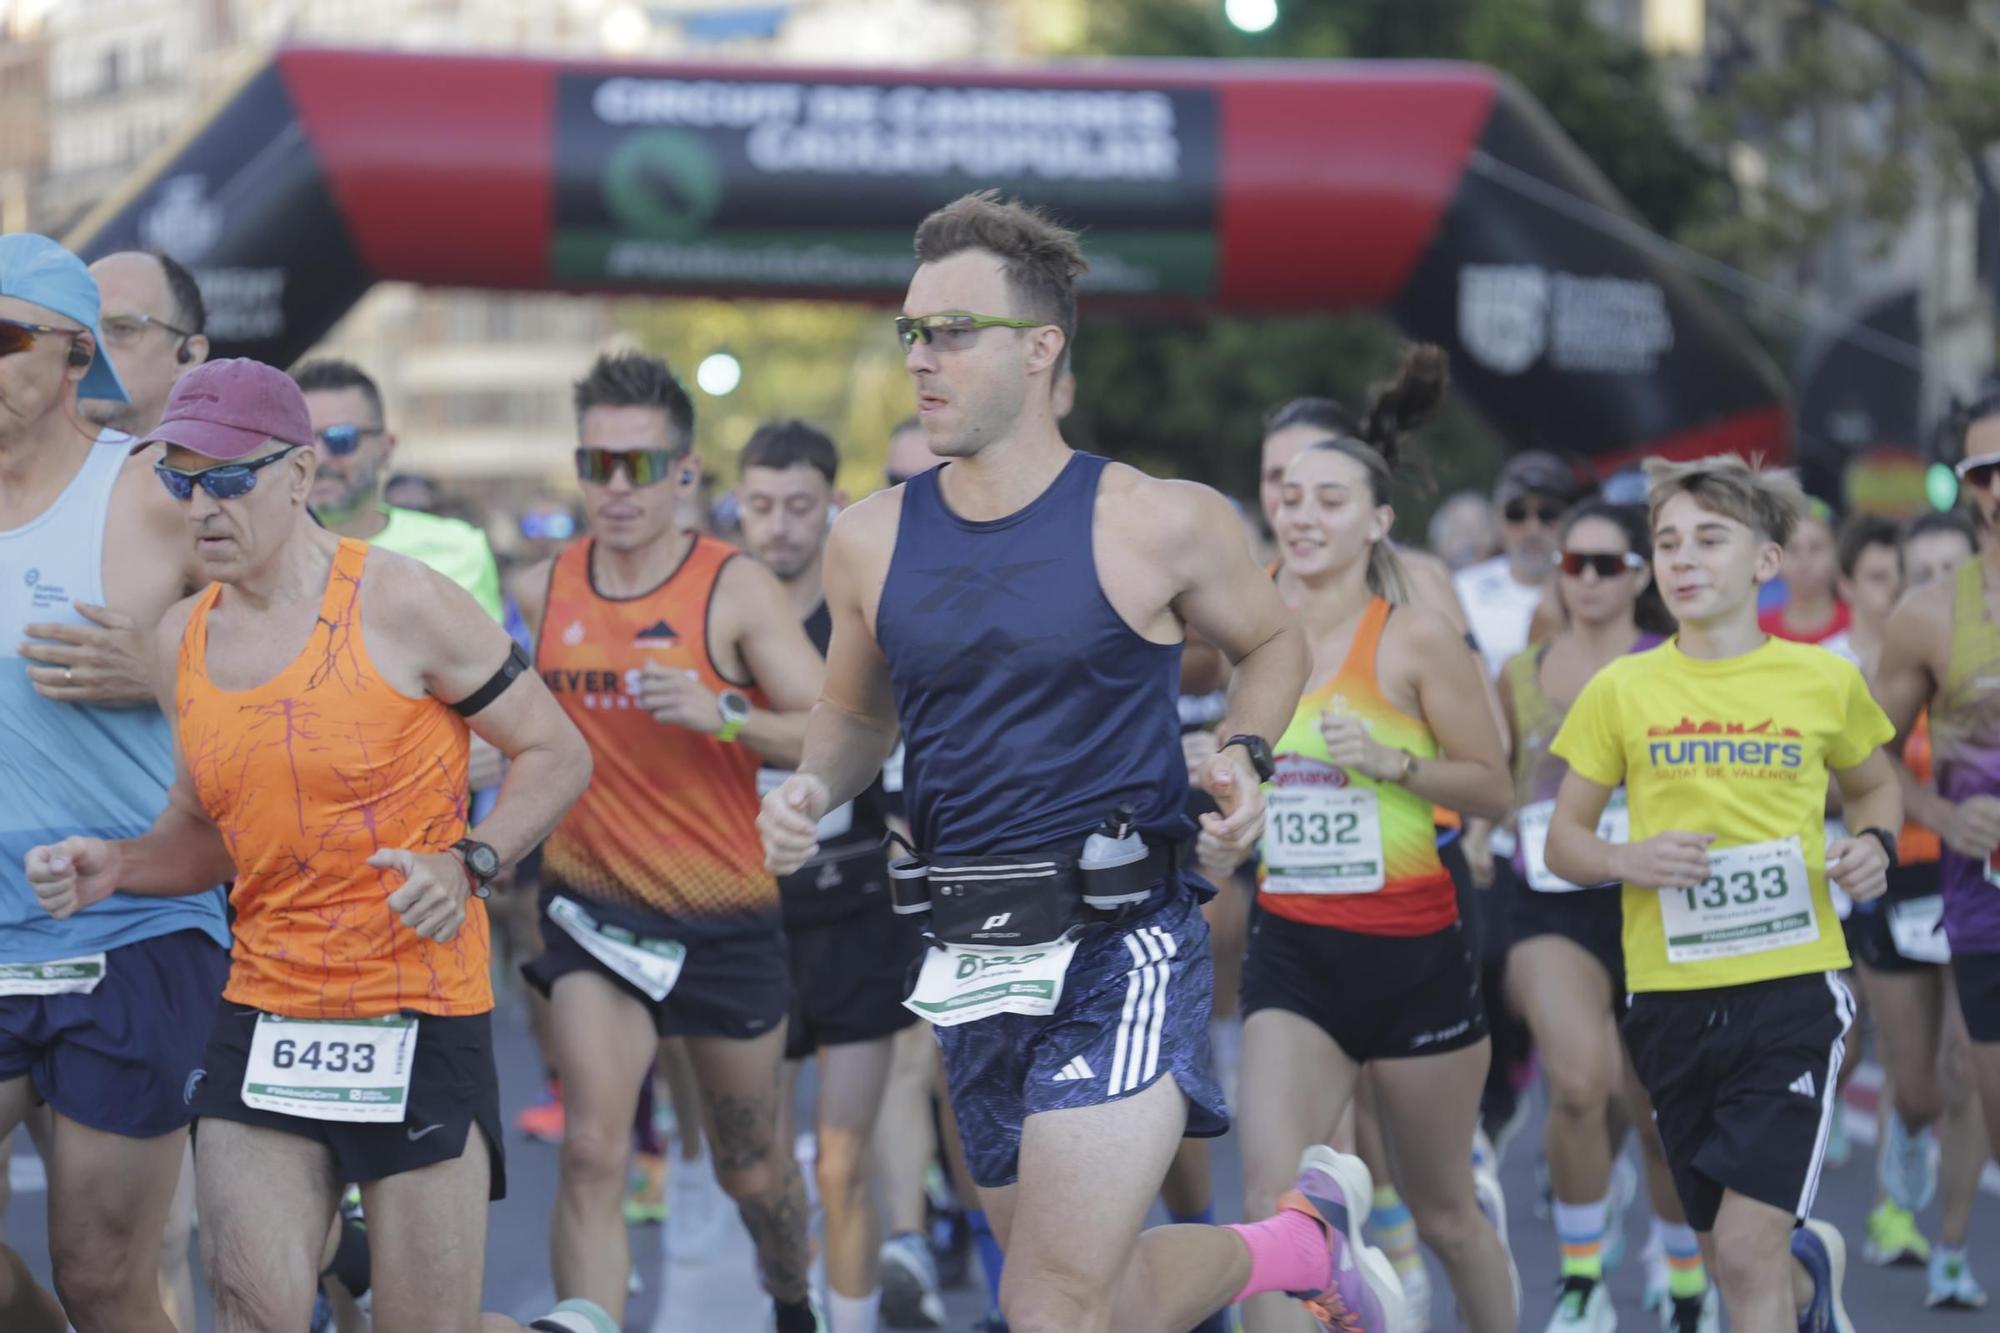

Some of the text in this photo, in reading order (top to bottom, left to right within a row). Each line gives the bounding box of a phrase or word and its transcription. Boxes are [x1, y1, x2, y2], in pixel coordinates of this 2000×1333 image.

[594, 77, 800, 127] CIRCUIT
[1649, 738, 1803, 768] runners
[1705, 767, 1724, 778] DE
[1272, 811, 1362, 845] 1332
[1677, 865, 1790, 911] 1333
[272, 1039, 376, 1073] 6433
